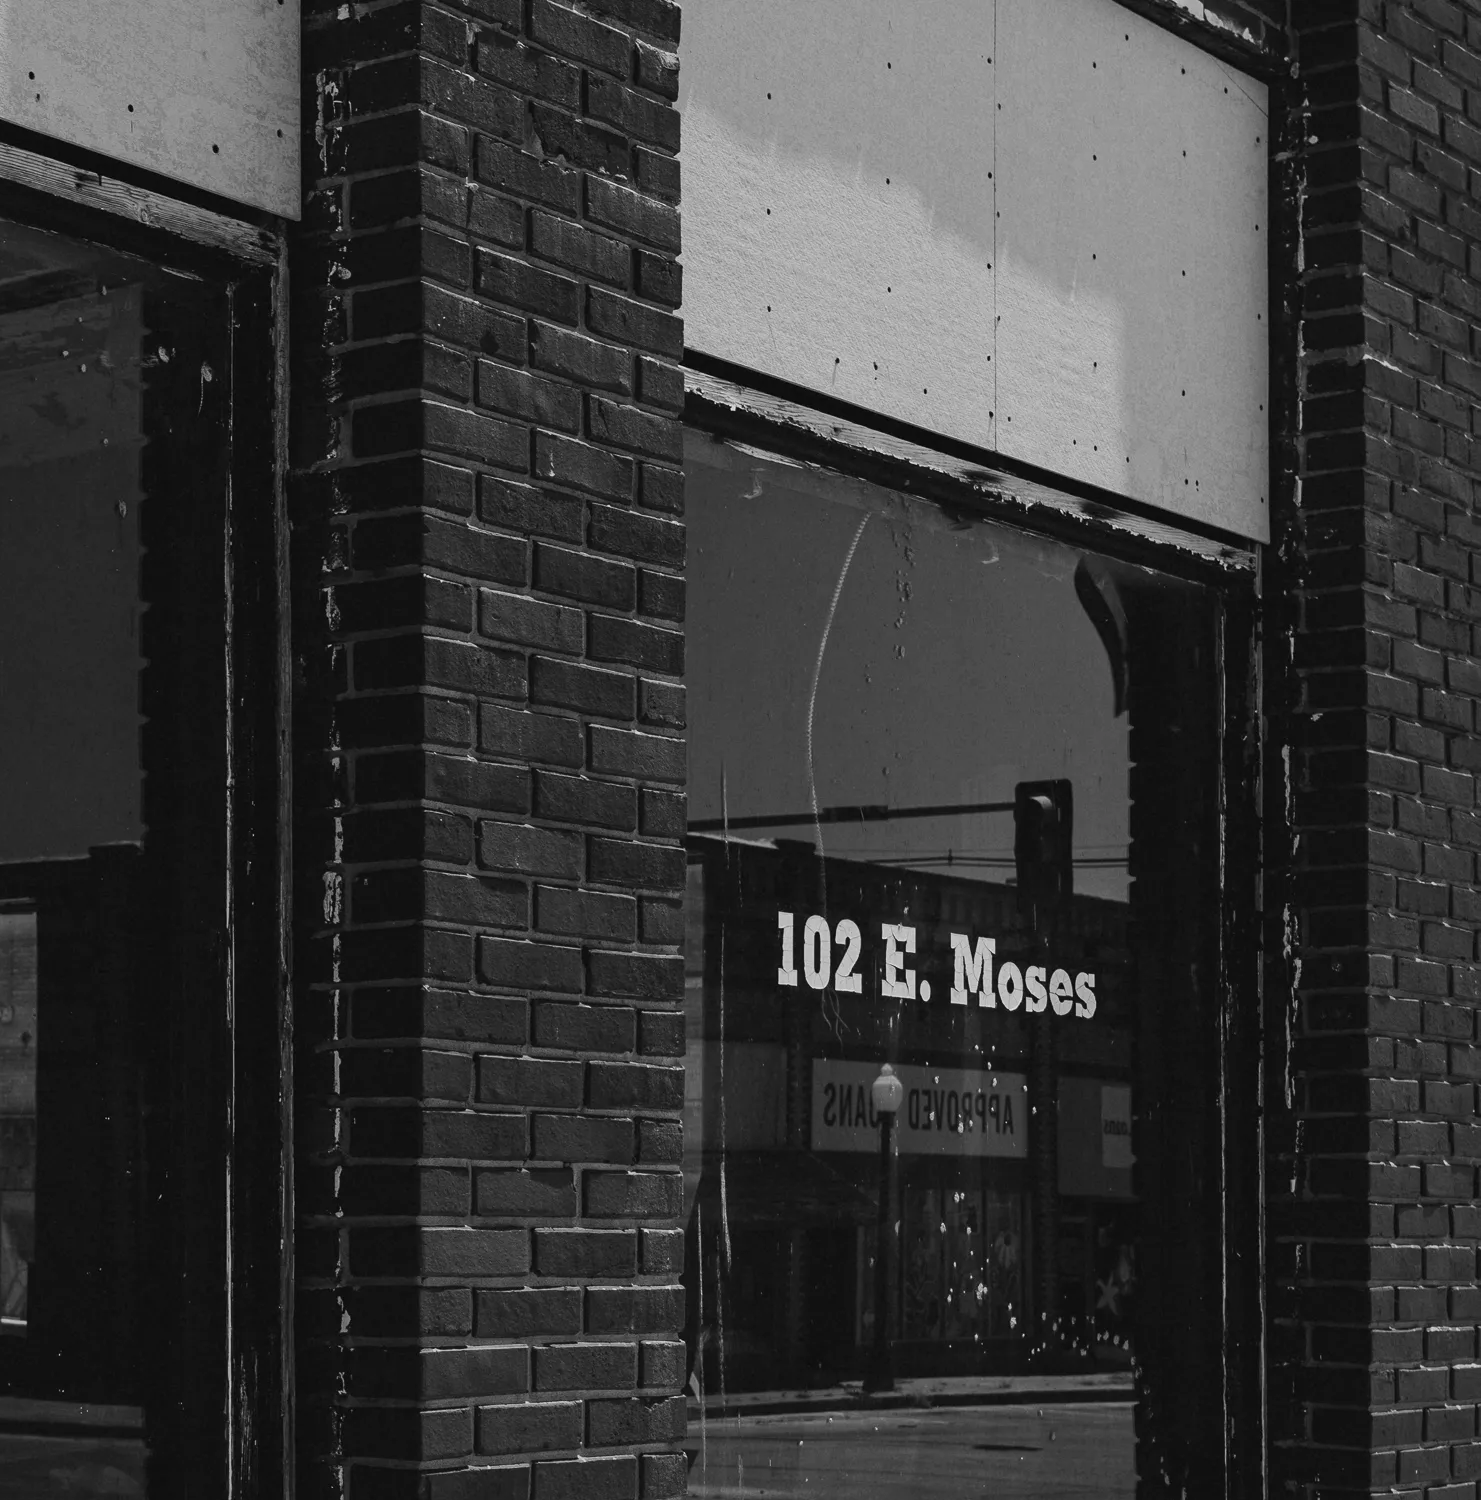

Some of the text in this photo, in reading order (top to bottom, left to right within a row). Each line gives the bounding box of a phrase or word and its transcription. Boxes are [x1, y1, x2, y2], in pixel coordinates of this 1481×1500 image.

[777, 911, 1097, 1018] 102 E. Moses
